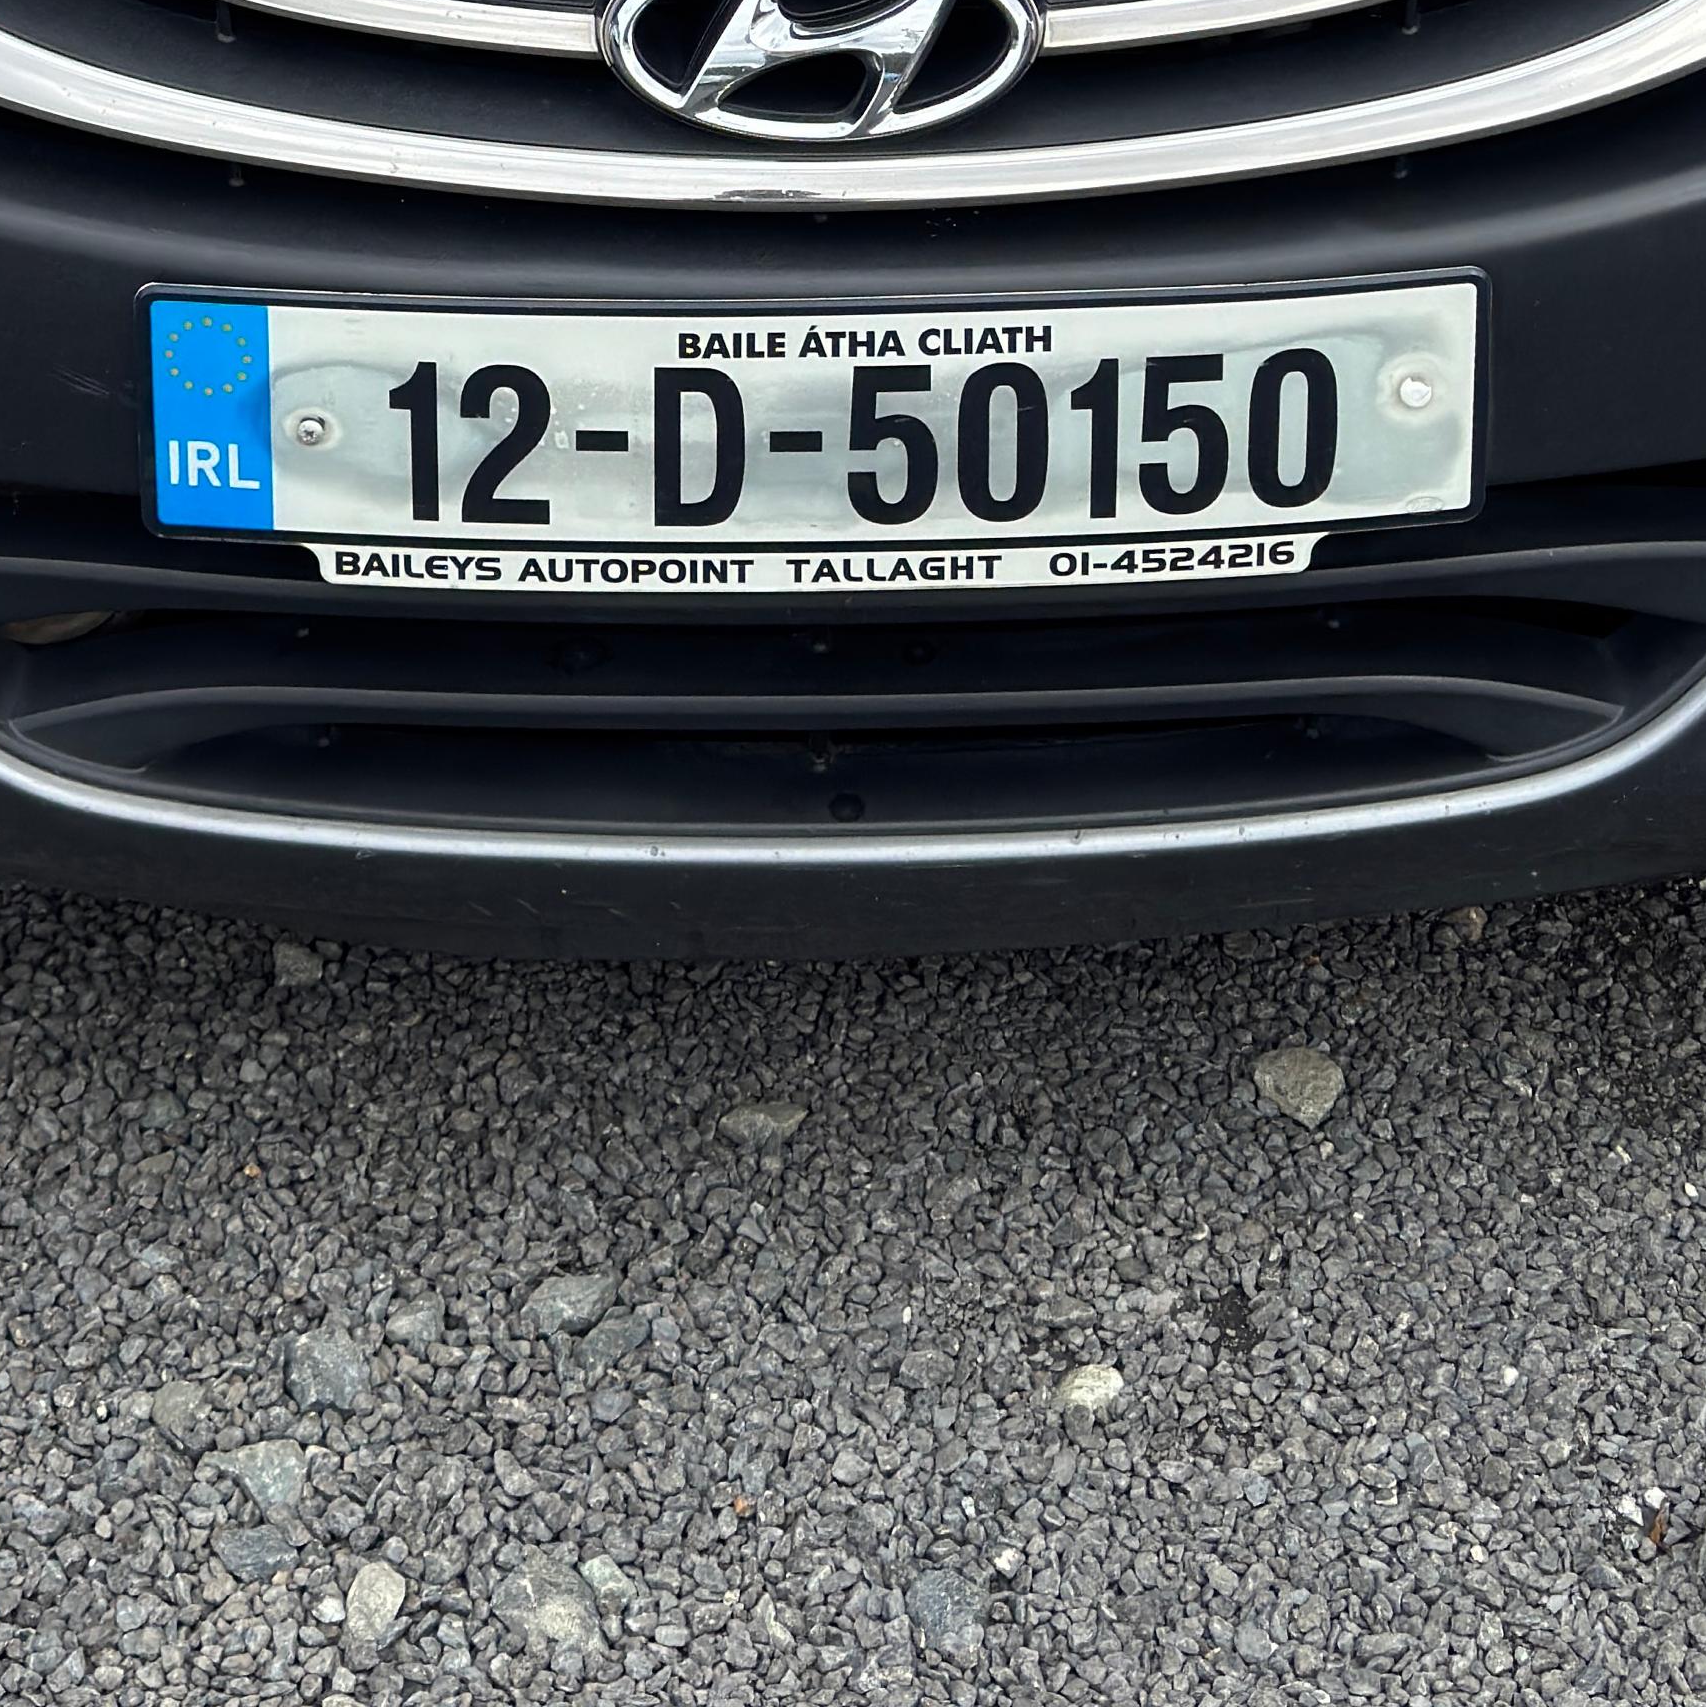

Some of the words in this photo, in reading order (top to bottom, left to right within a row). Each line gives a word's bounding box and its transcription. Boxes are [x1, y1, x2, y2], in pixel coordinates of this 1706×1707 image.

[677, 331, 787, 360] BAILE
[797, 324, 906, 359] ÁTHA
[917, 324, 1053, 357] CLIATH
[388, 346, 1339, 527] 12-D-50150
[167, 439, 261, 490] IRL
[334, 550, 502, 583] BAILEYS
[517, 558, 755, 584] AUTOPOINT
[785, 554, 1003, 584] TALLAGHT
[1048, 540, 1296, 577] 01-4524216
